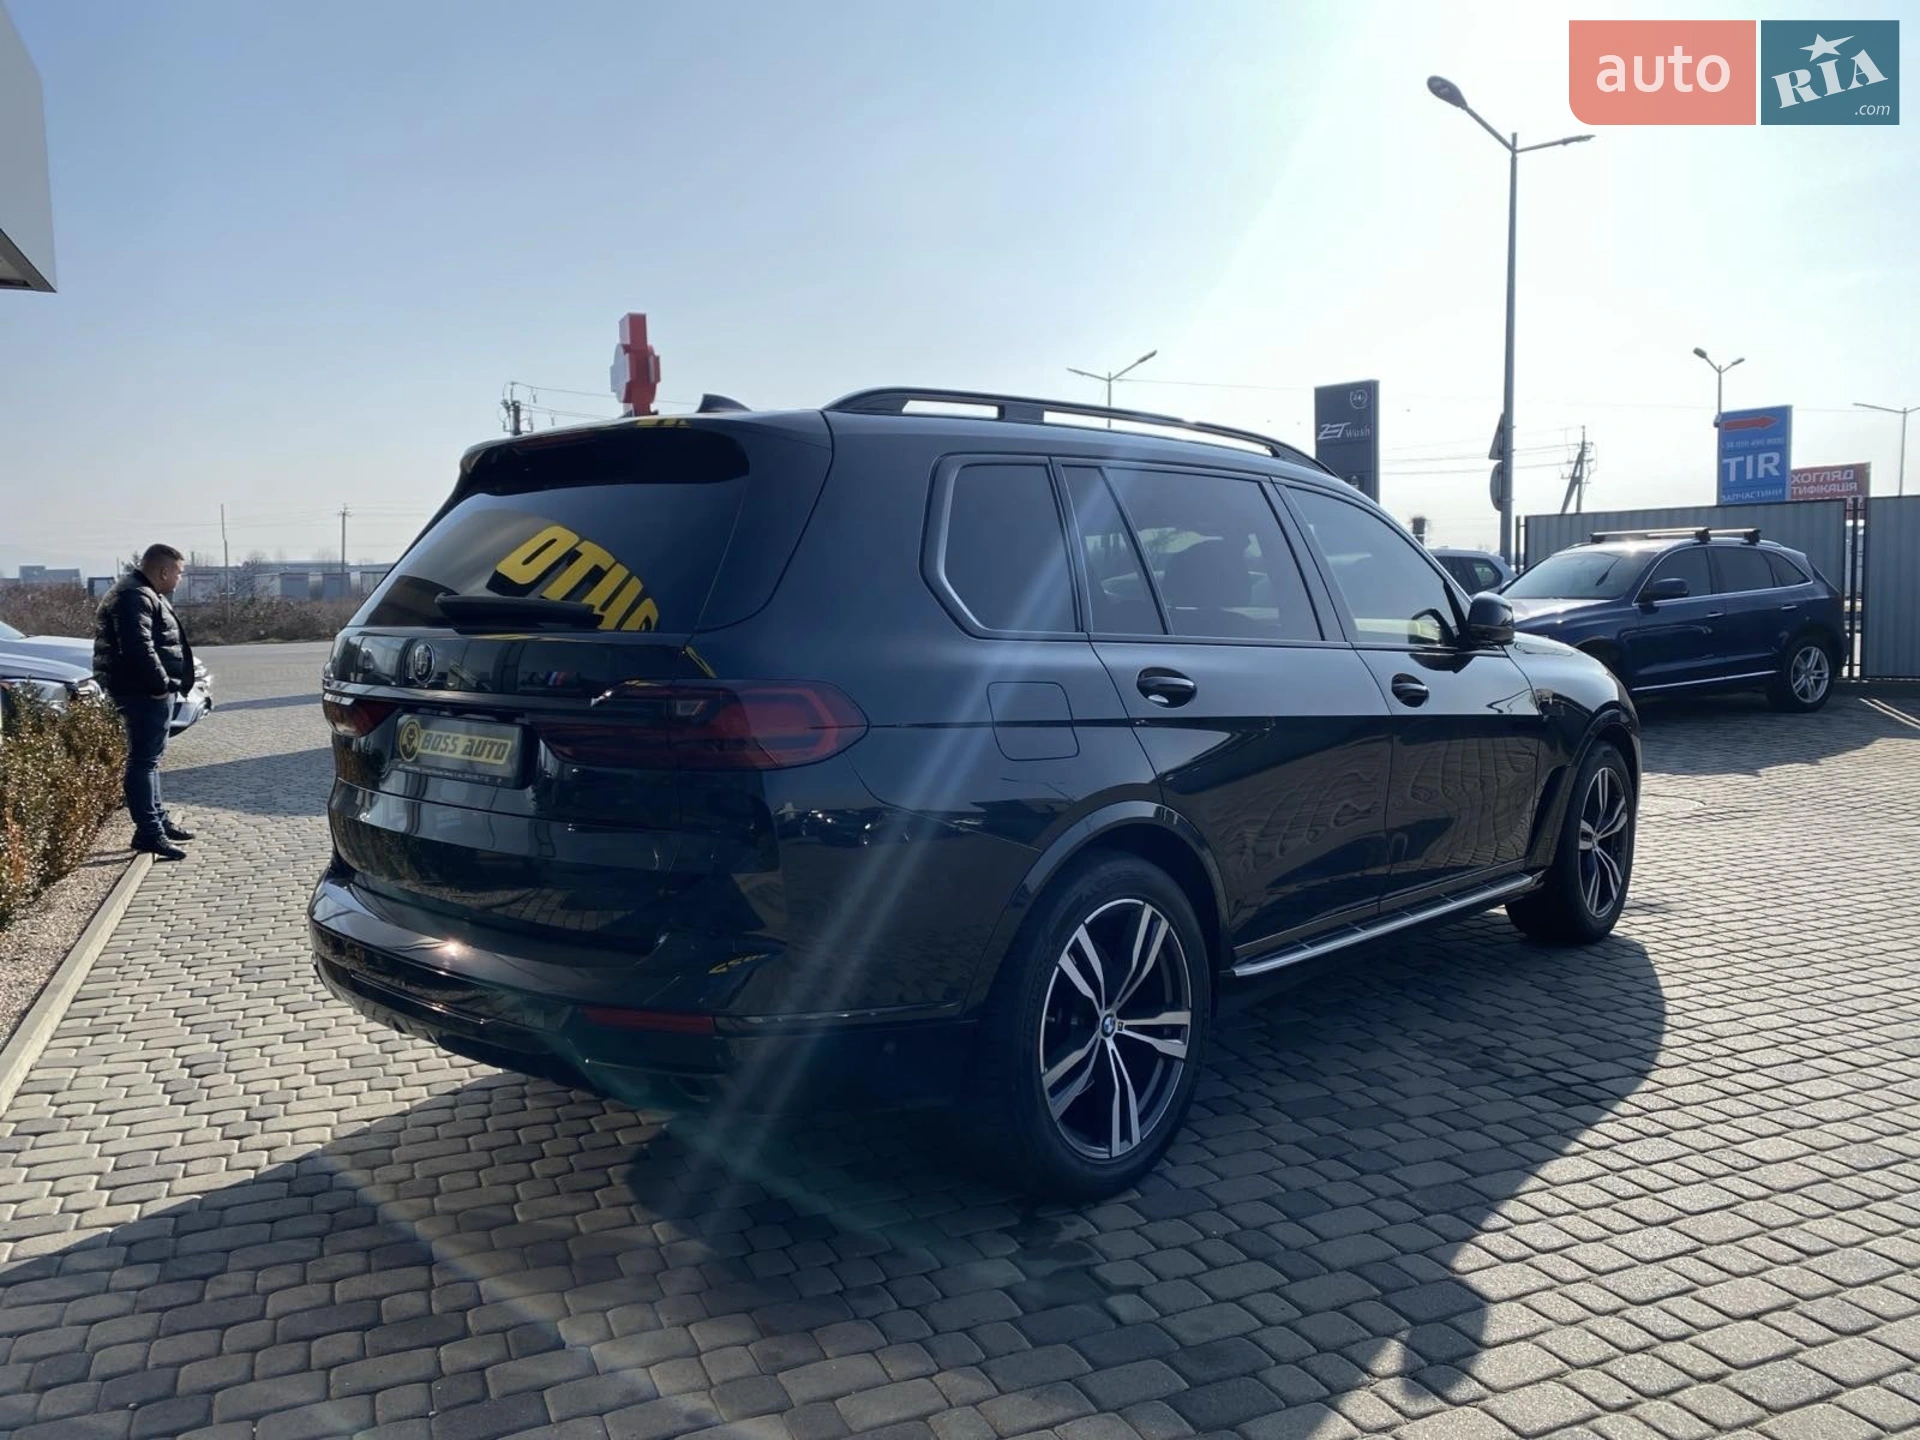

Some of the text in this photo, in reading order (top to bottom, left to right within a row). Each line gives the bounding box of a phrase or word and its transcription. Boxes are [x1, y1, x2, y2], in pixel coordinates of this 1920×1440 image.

[1722, 452, 1781, 482] TIR
[420, 732, 510, 761] BOSS AUTO
